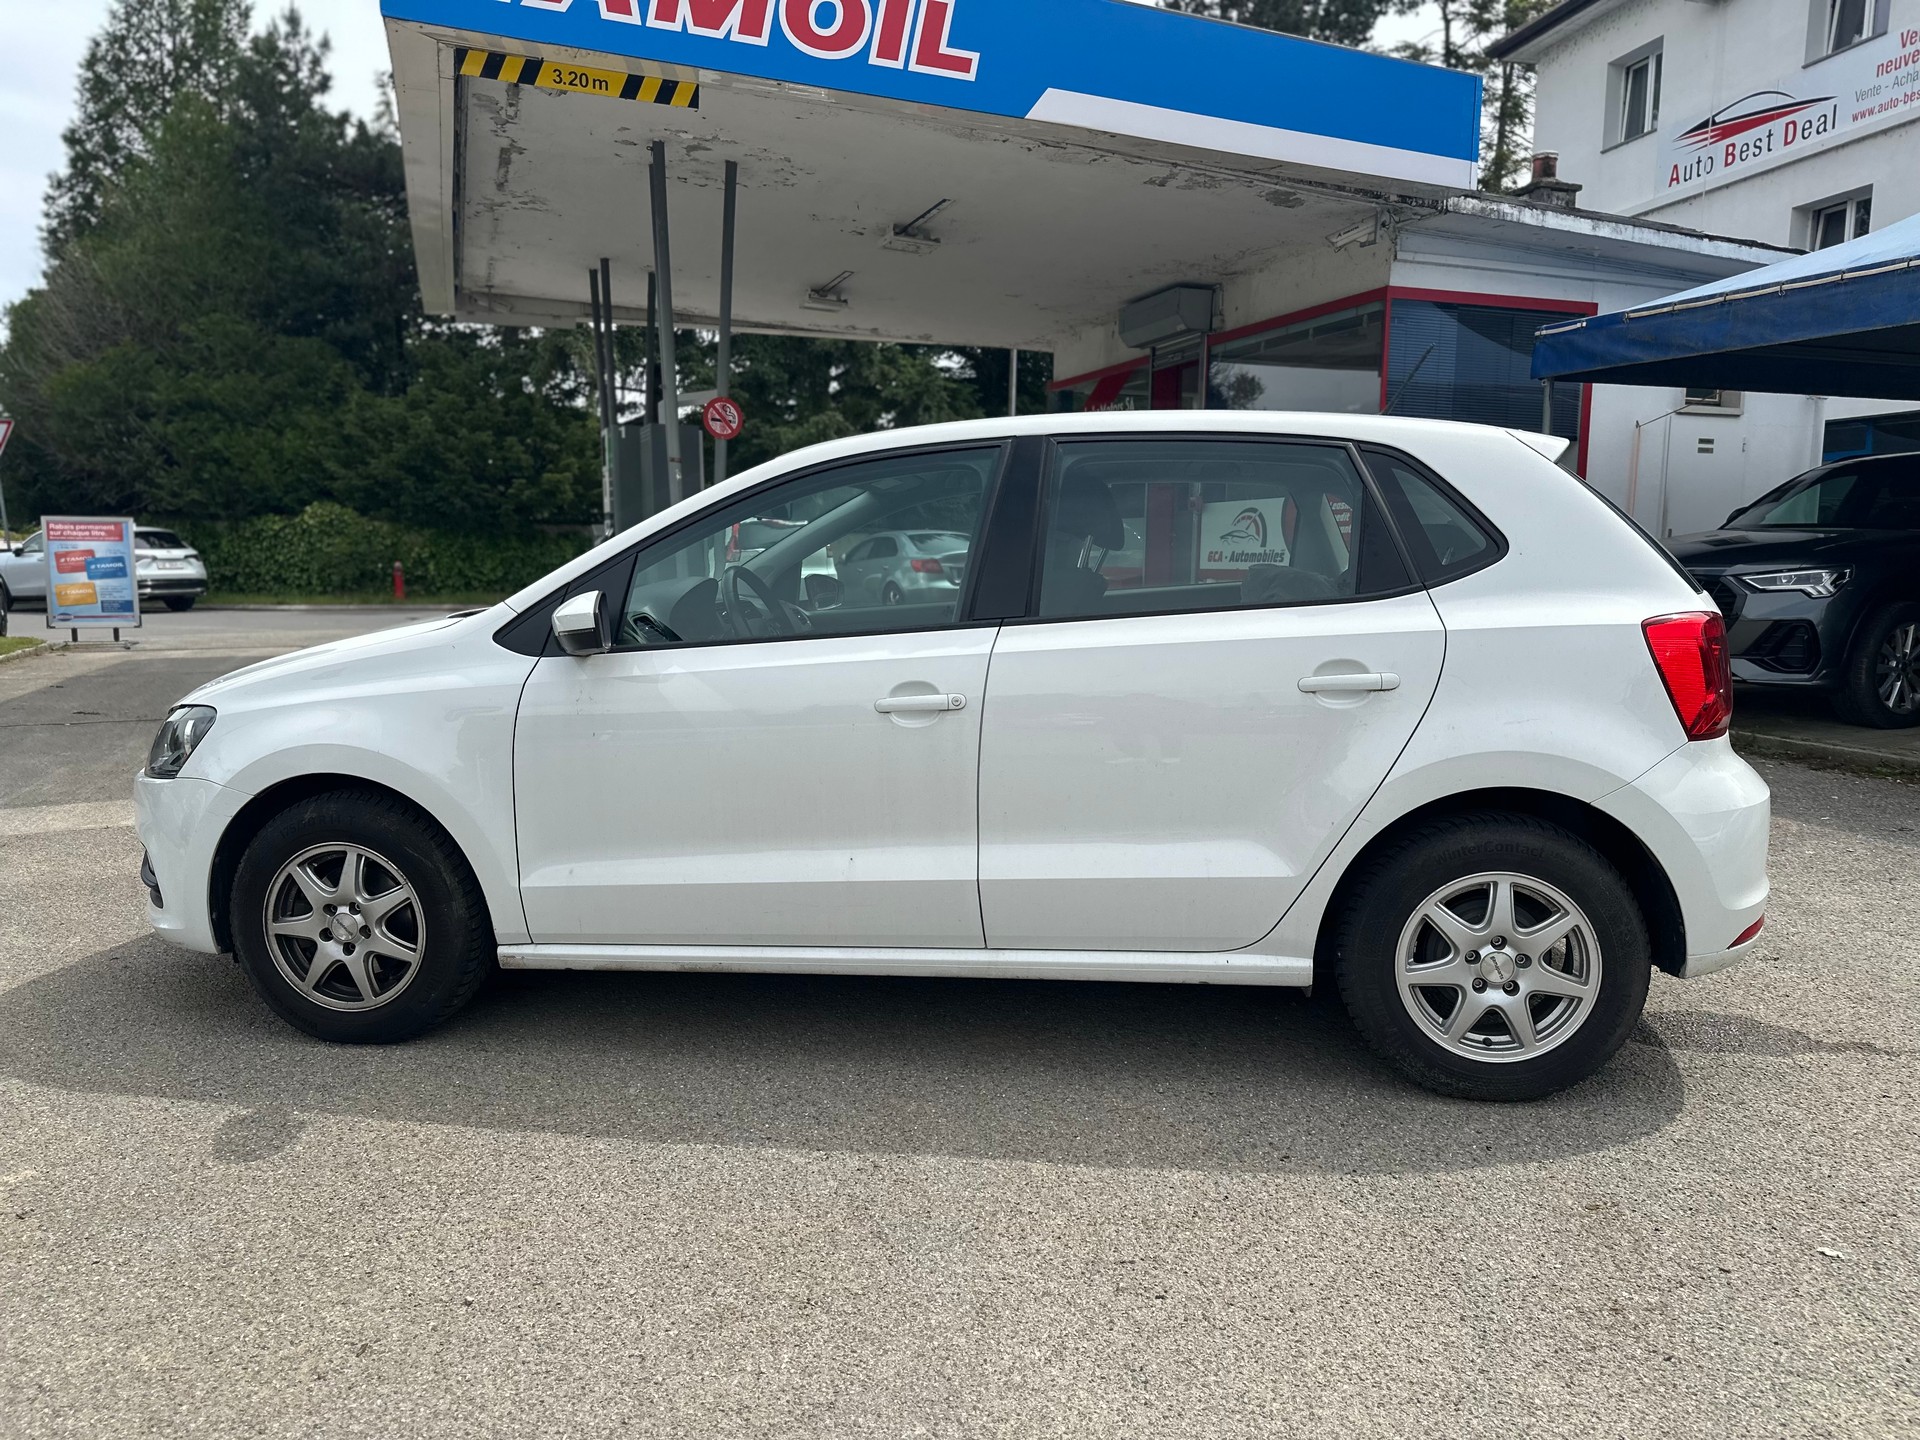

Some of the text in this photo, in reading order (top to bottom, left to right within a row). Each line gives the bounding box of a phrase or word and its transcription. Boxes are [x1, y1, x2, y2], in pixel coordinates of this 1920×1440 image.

[497, 0, 980, 82] OIL
[1900, 28, 1920, 49] Ve
[552, 68, 609, 91] 3.20 m
[1855, 84, 1882, 103] Vente
[1668, 103, 1838, 188] Auto Best Deal
[1207, 550, 1223, 563] GCA
[1229, 549, 1286, 563] Automobiles
